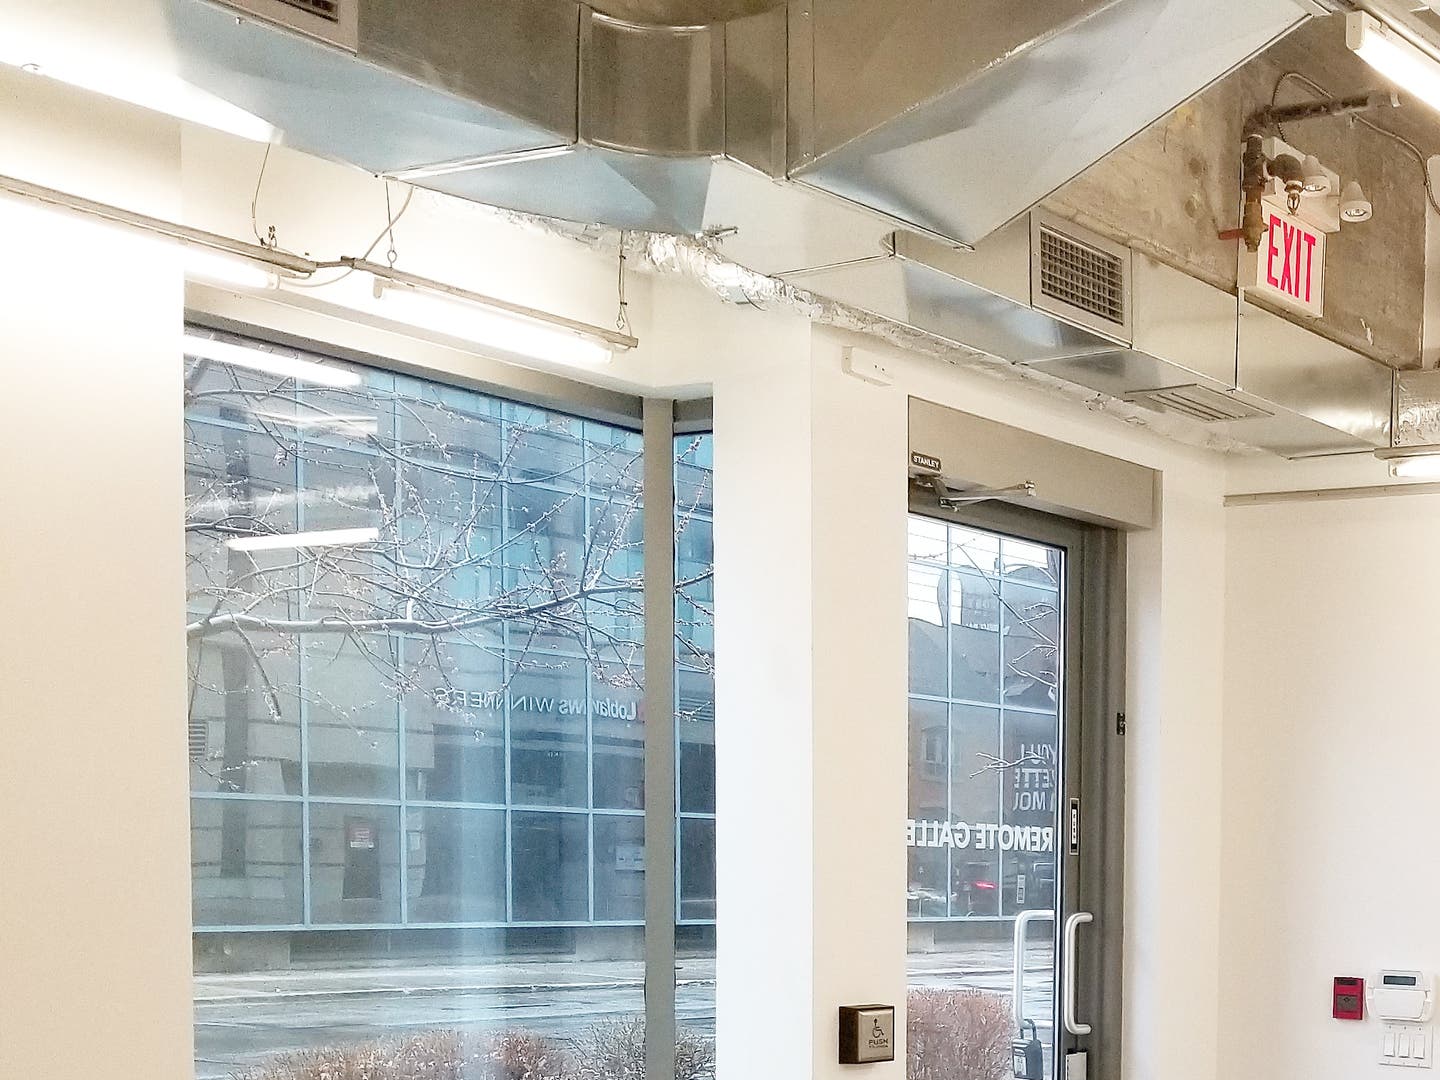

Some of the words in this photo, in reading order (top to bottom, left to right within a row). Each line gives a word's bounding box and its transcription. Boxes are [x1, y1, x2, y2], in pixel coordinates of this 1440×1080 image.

[1266, 213, 1317, 302] EXIT
[913, 455, 940, 469] STANLEY
[868, 1038, 889, 1046] PUSH
